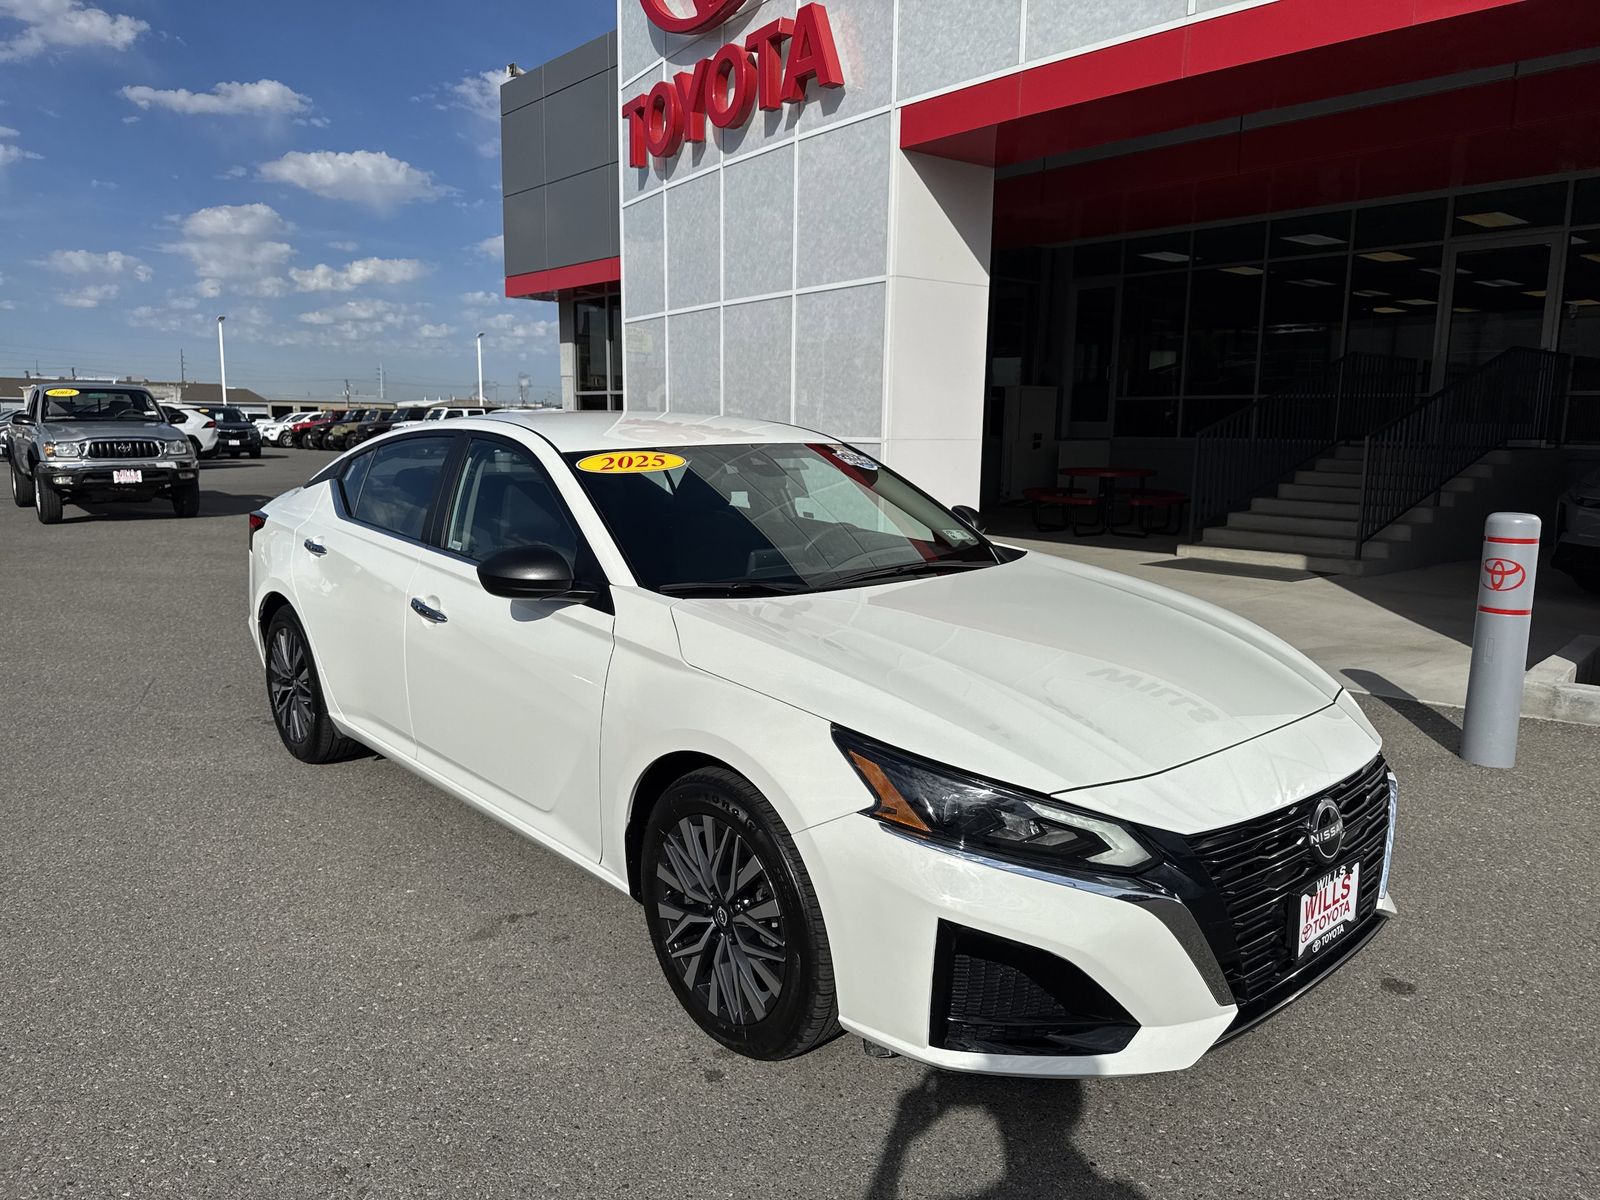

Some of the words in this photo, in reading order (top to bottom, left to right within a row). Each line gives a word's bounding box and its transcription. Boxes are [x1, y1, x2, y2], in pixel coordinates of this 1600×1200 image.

[622, 2, 845, 168] TOYOTA
[600, 455, 665, 470] 2025
[1310, 820, 1343, 844] NISSA
[1316, 865, 1347, 891] WILLS
[1305, 873, 1351, 924] WILLS
[1313, 899, 1351, 934] TOYOTA
[1321, 923, 1345, 946] TOYOTA
